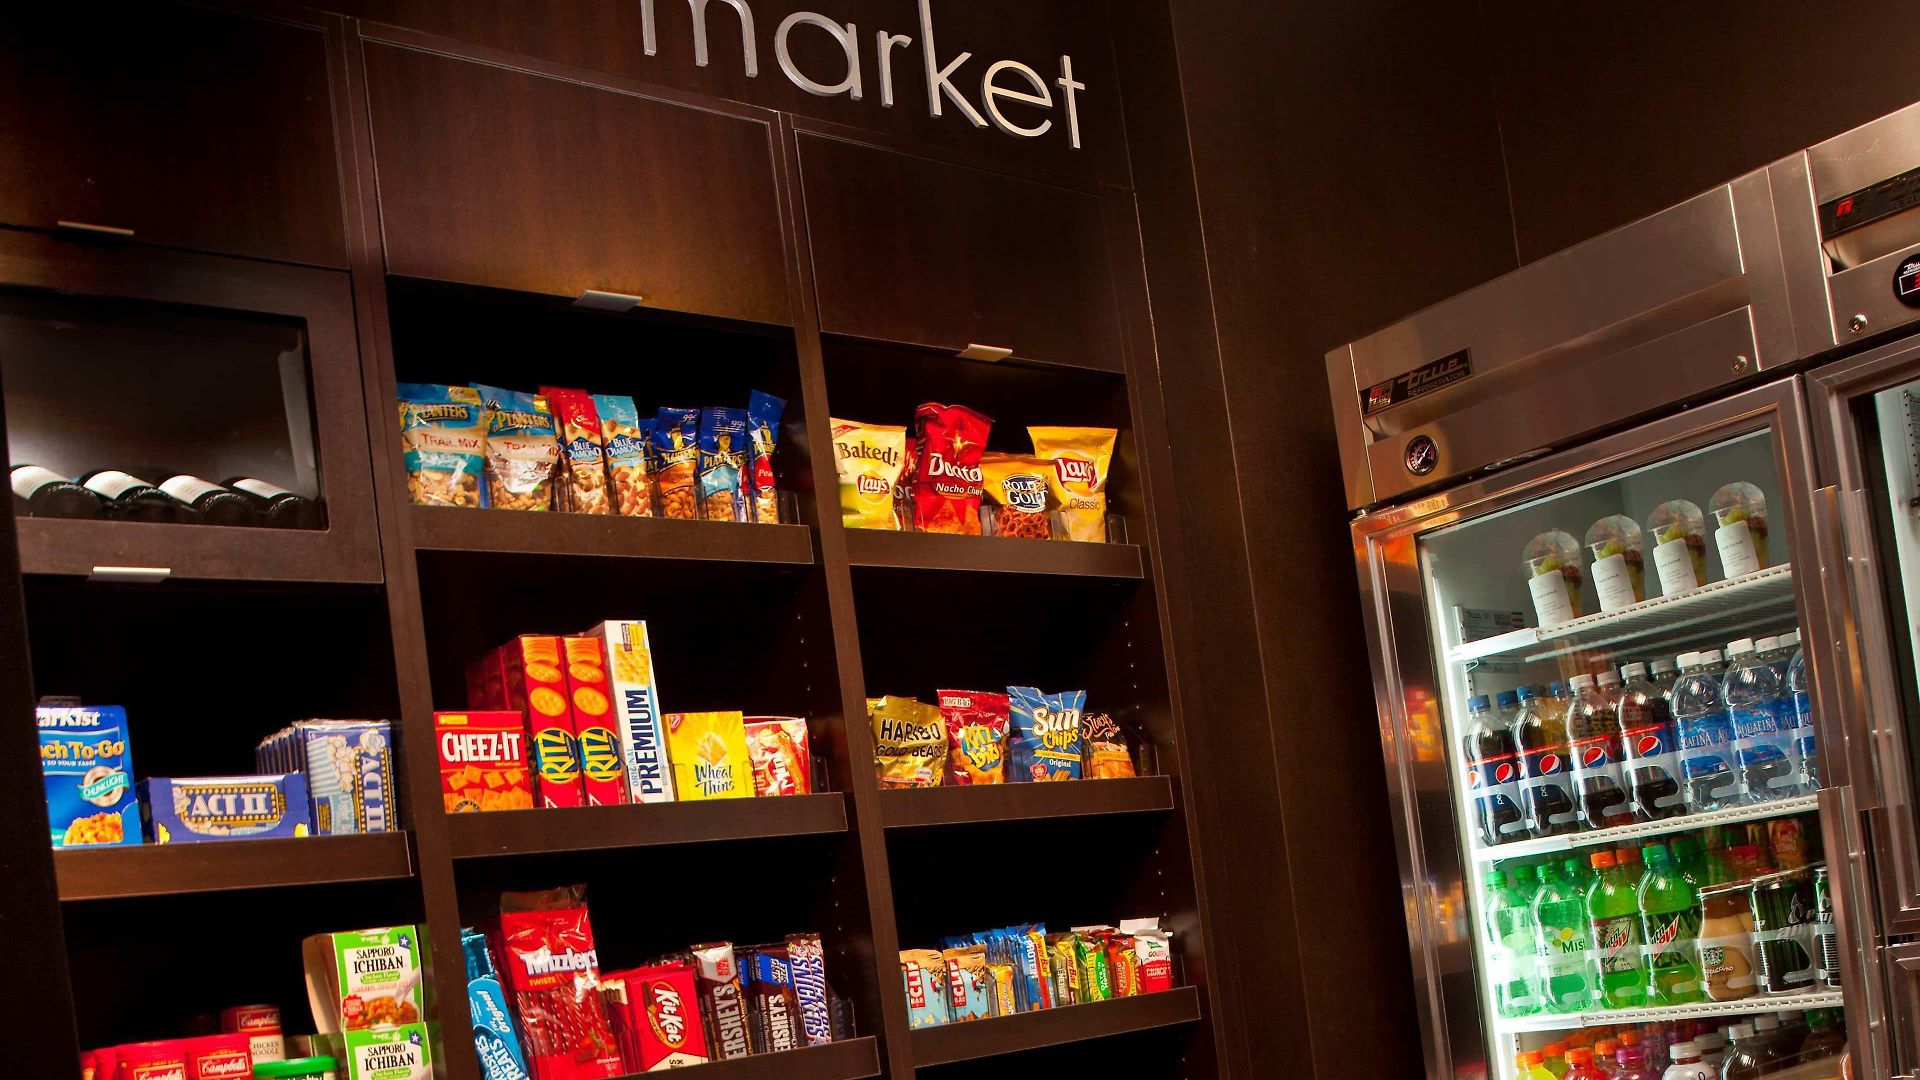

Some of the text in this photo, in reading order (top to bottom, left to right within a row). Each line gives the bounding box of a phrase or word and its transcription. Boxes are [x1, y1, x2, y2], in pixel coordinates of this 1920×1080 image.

[638, 0, 1086, 150] market
[573, 440, 592, 451] BLUE
[605, 441, 645, 458] DIAMOND
[612, 437, 634, 449] BLUE
[836, 440, 899, 467] Baked!
[927, 453, 982, 483] Dorito
[935, 483, 983, 496] Nacho Chee
[1069, 496, 1102, 511] Classic
[880, 719, 942, 743] HARIBO
[1033, 706, 1080, 737] Sun
[1737, 716, 1778, 738] AQUAFINA
[441, 731, 520, 763] CHEEZ-IT
[625, 689, 663, 795] PREMIUM
[1042, 729, 1079, 751] Chips
[537, 731, 579, 779] RITZ
[581, 730, 621, 778] RITZ
[1049, 758, 1072, 768] Original
[361, 756, 383, 801] ACT
[694, 763, 734, 784] Wheat
[694, 780, 736, 797] Thins
[190, 793, 269, 816] ACT II
[356, 946, 395, 959] SAPPORO
[519, 947, 598, 976] Twizzlers
[354, 955, 404, 974] ICHIBAN
[905, 961, 924, 998] CLIF
[949, 960, 966, 997] CLIF
[713, 983, 748, 1060] ERSHEY'S
[768, 993, 791, 1053] ERSHEY'S
[367, 1043, 406, 1056] SAPPORO
[364, 1052, 415, 1071] ICHIBAN
